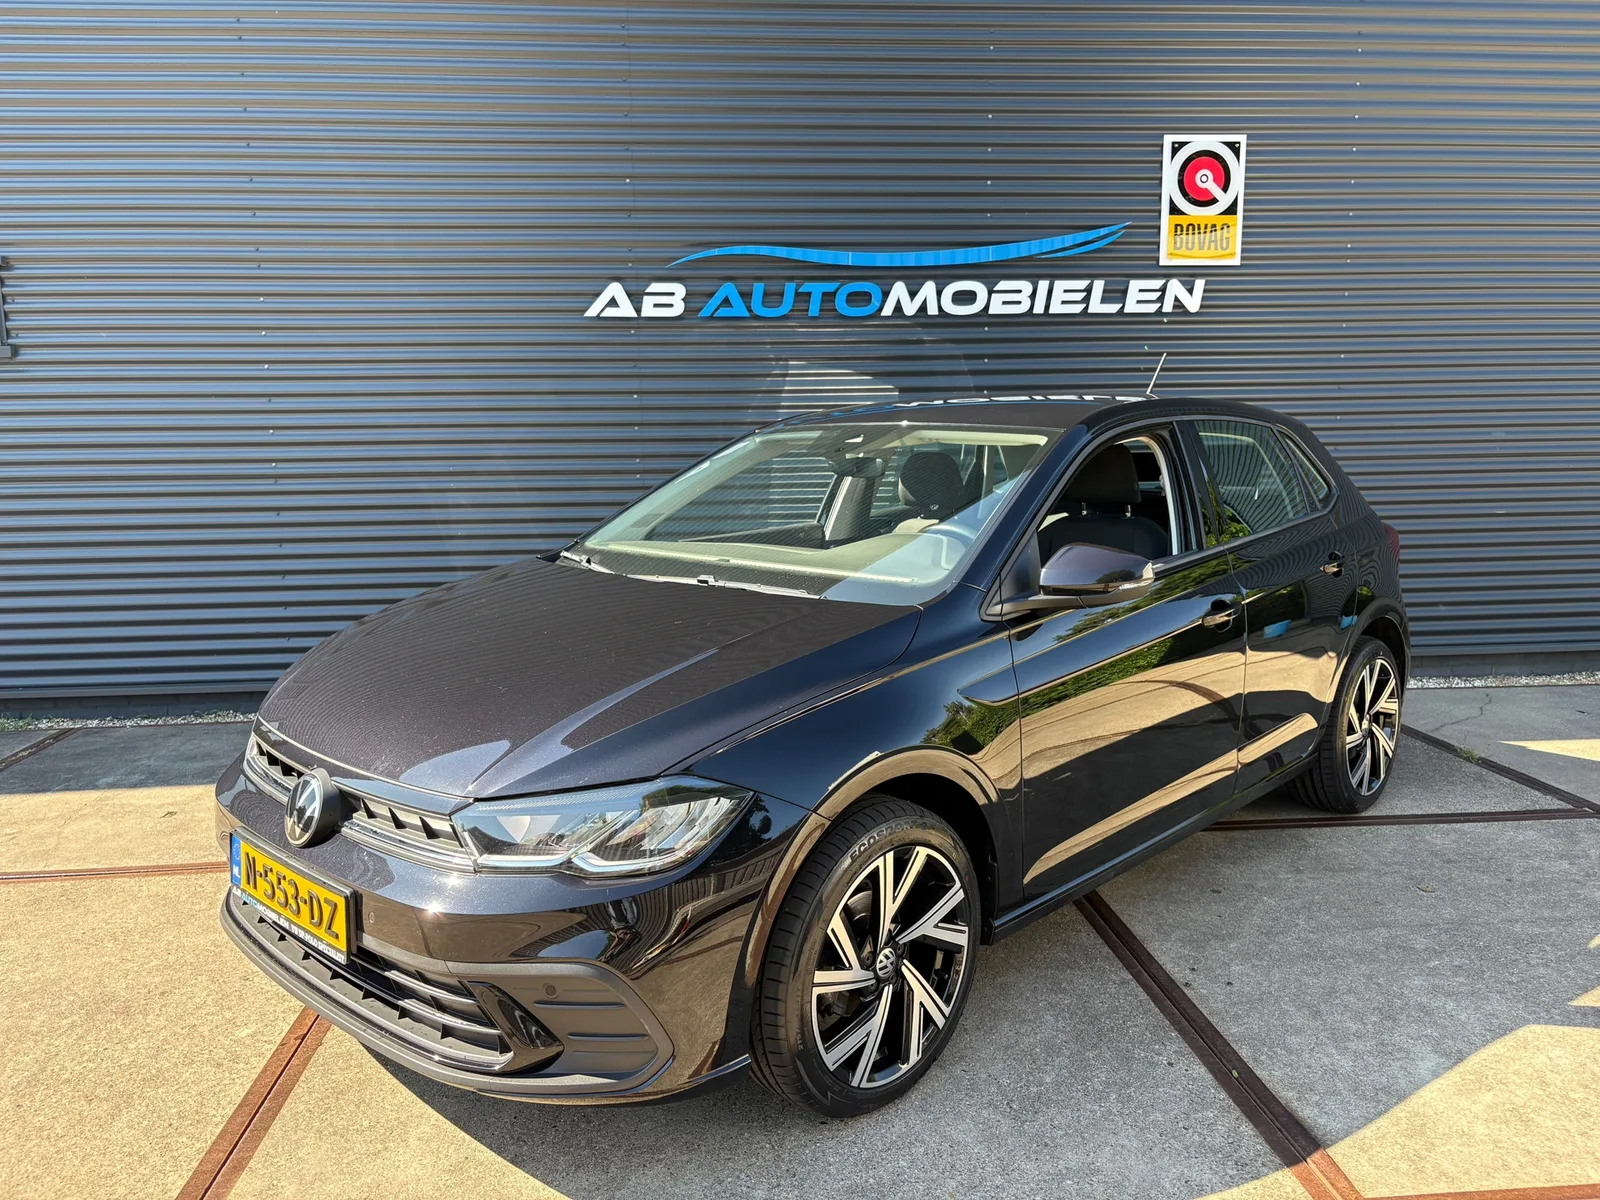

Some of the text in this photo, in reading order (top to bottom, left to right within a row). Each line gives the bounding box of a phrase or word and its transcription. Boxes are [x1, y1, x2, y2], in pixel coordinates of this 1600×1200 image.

[1173, 223, 1231, 252] BOVAG
[583, 278, 1206, 318] AB AUTOMOBIELEN
[232, 864, 241, 878] NL
[244, 850, 340, 941] N-553-DZ
